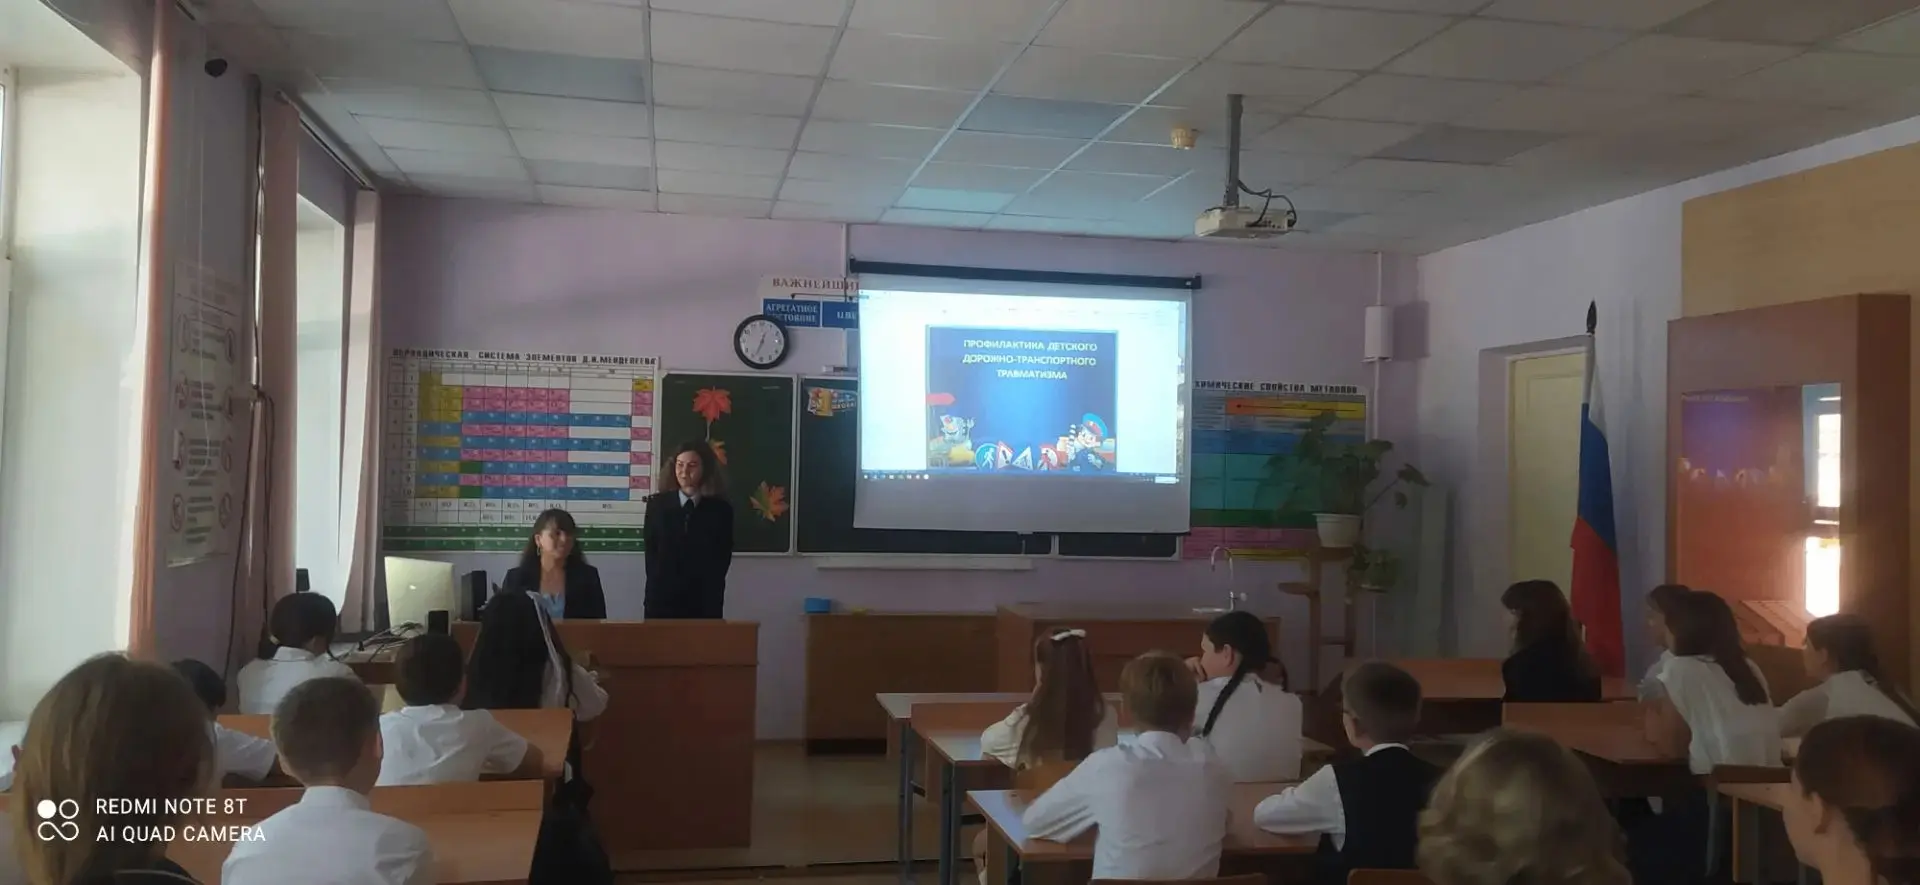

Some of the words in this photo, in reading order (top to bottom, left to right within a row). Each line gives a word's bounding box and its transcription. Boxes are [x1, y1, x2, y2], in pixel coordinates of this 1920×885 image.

[772, 278, 859, 291] ВАЖНЕЙШИ
[766, 303, 818, 313] АГРЕГАТНОЕ
[963, 339, 1045, 350] ПРОФИЛАКТИКА
[1047, 341, 1098, 352] ДЕТСКОГО
[478, 351, 520, 360] СИСТЕМА
[526, 353, 577, 363] ЭЛЕМЕНТОВ
[962, 354, 1097, 366] ДОРОЖНО-ТРАНСПОРТНОГО
[997, 369, 1068, 380] ТРАВМАТИЗМА
[1260, 382, 1305, 392] СВОЙСТВА
[1310, 384, 1358, 394] МЕТАЛЛОВ
